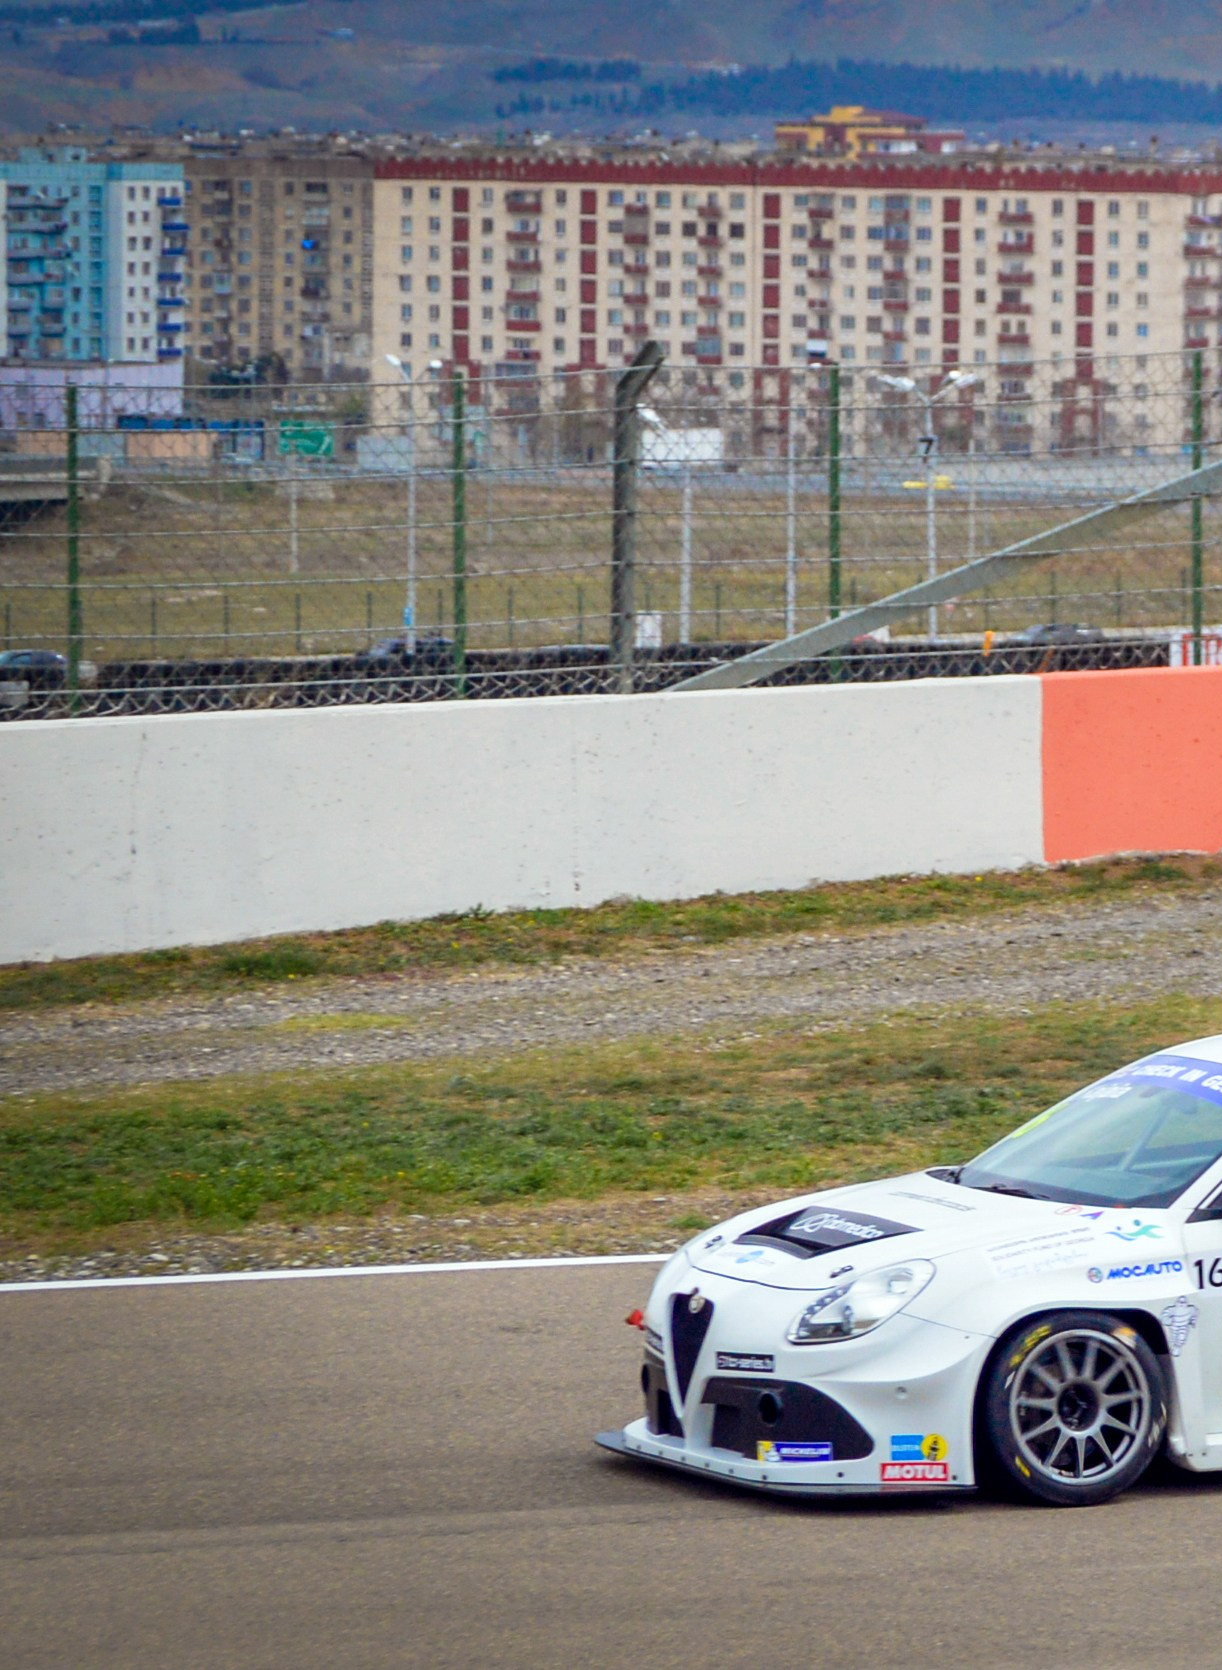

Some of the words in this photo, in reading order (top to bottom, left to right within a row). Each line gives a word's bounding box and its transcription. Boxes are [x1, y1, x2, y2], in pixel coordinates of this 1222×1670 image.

[1131, 1063, 1181, 1079] CHECK
[1178, 1068, 1208, 1083] IN
[1106, 1260, 1183, 1280] MOCAUTO
[882, 1464, 946, 1480] MOTUL
